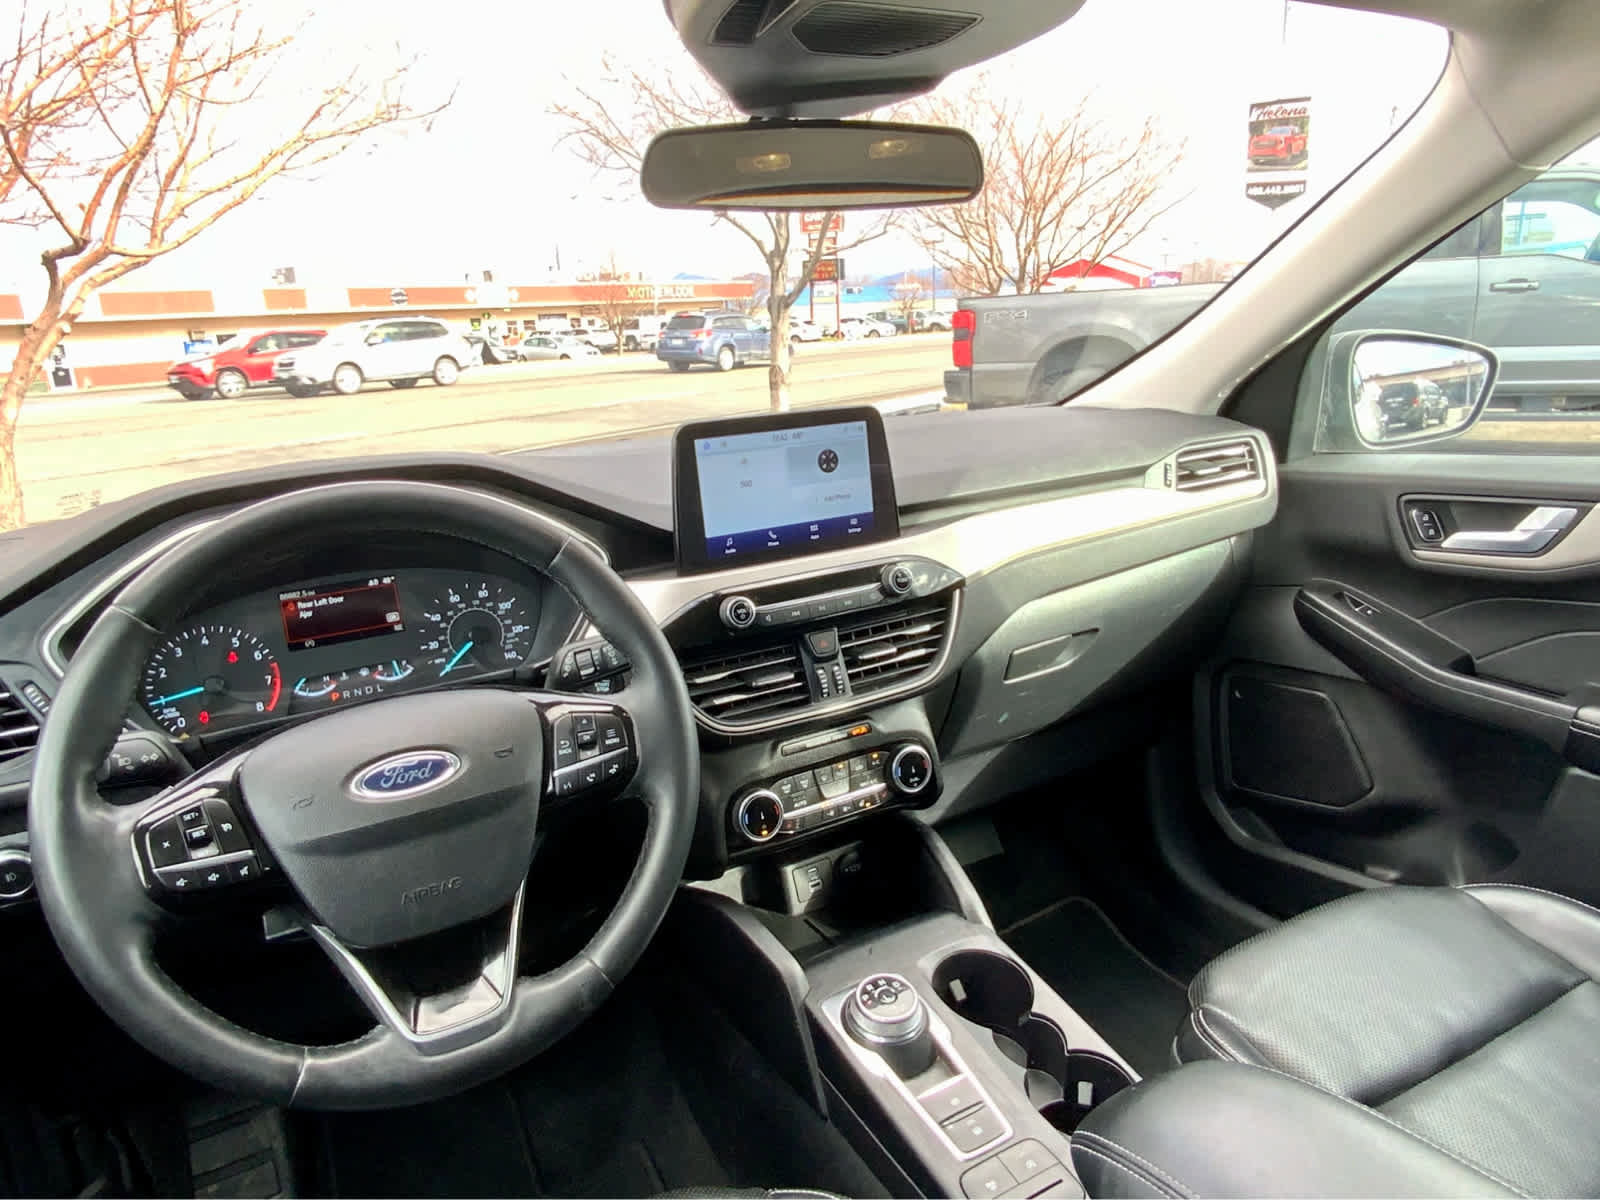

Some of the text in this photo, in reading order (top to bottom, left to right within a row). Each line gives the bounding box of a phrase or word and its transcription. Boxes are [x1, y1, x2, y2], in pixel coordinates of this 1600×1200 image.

[983, 309, 1029, 324] FX4
[201, 635, 209, 645] 4
[231, 637, 240, 648] 5
[174, 647, 183, 657] 3
[253, 650, 262, 660] 6
[159, 667, 168, 678] 2
[264, 675, 272, 686] 7
[255, 701, 264, 712] 8
[177, 717, 186, 728] 0
[380, 759, 433, 788] Ford
[401, 875, 464, 905] AIRBAG
